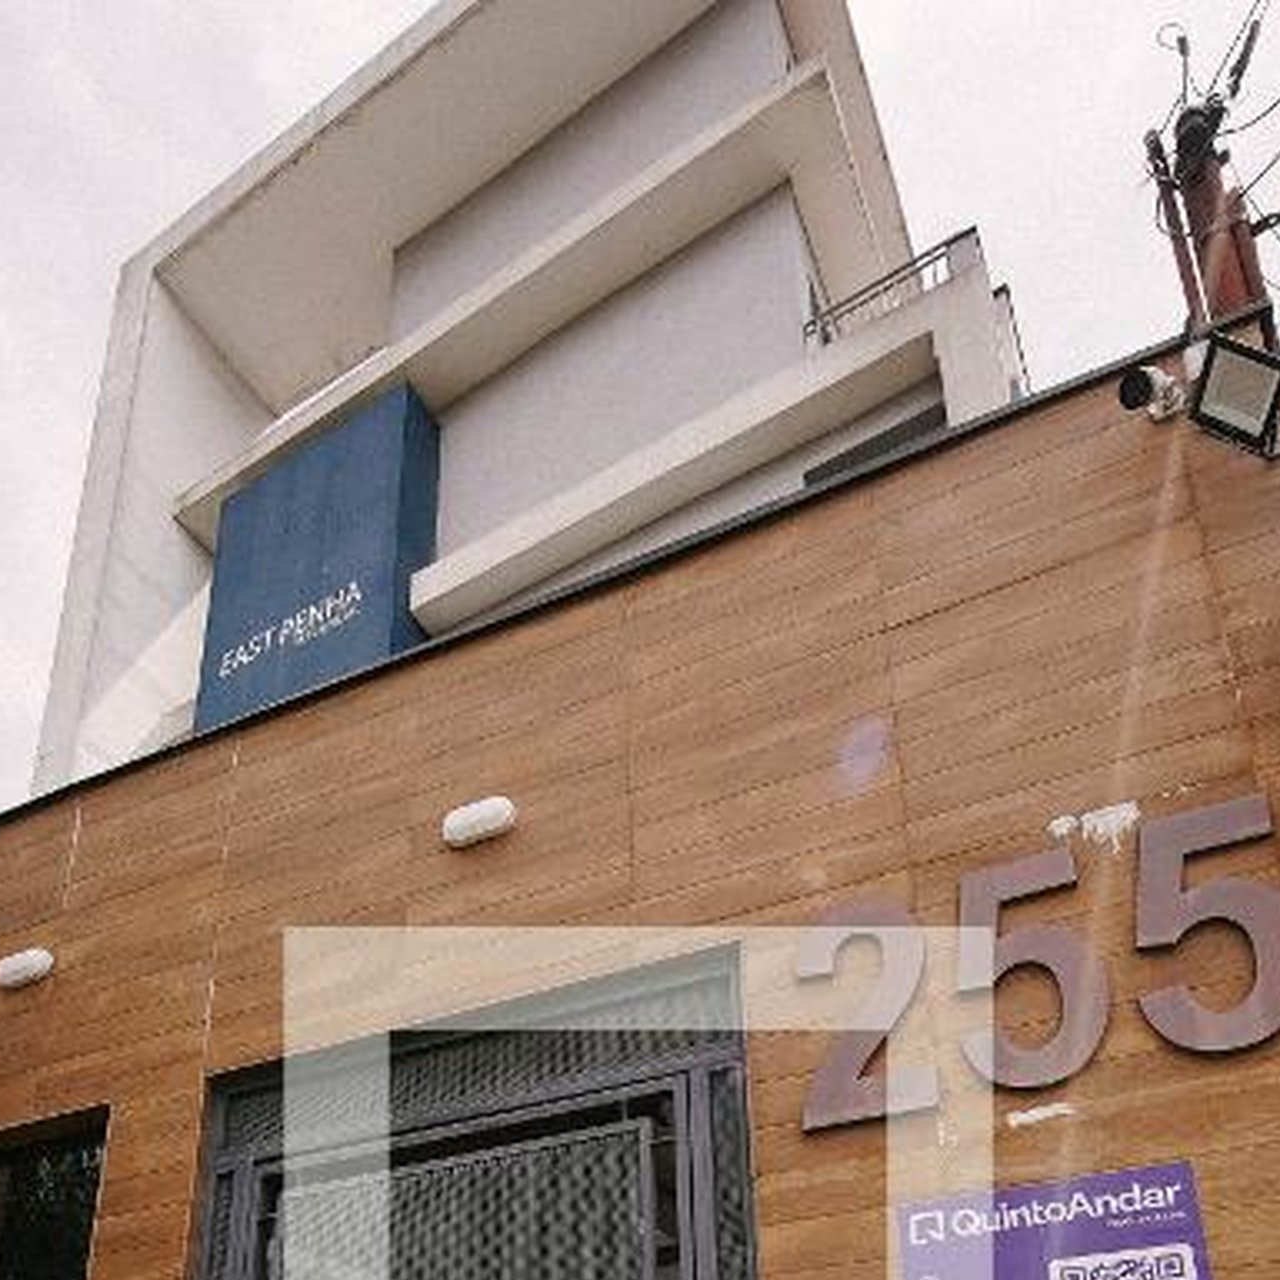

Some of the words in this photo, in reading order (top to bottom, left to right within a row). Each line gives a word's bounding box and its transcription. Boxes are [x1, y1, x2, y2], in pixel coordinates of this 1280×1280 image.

[219, 628, 277, 679] EAST
[278, 581, 363, 647] PENHA
[951, 1181, 1182, 1237] QuintoAndar
